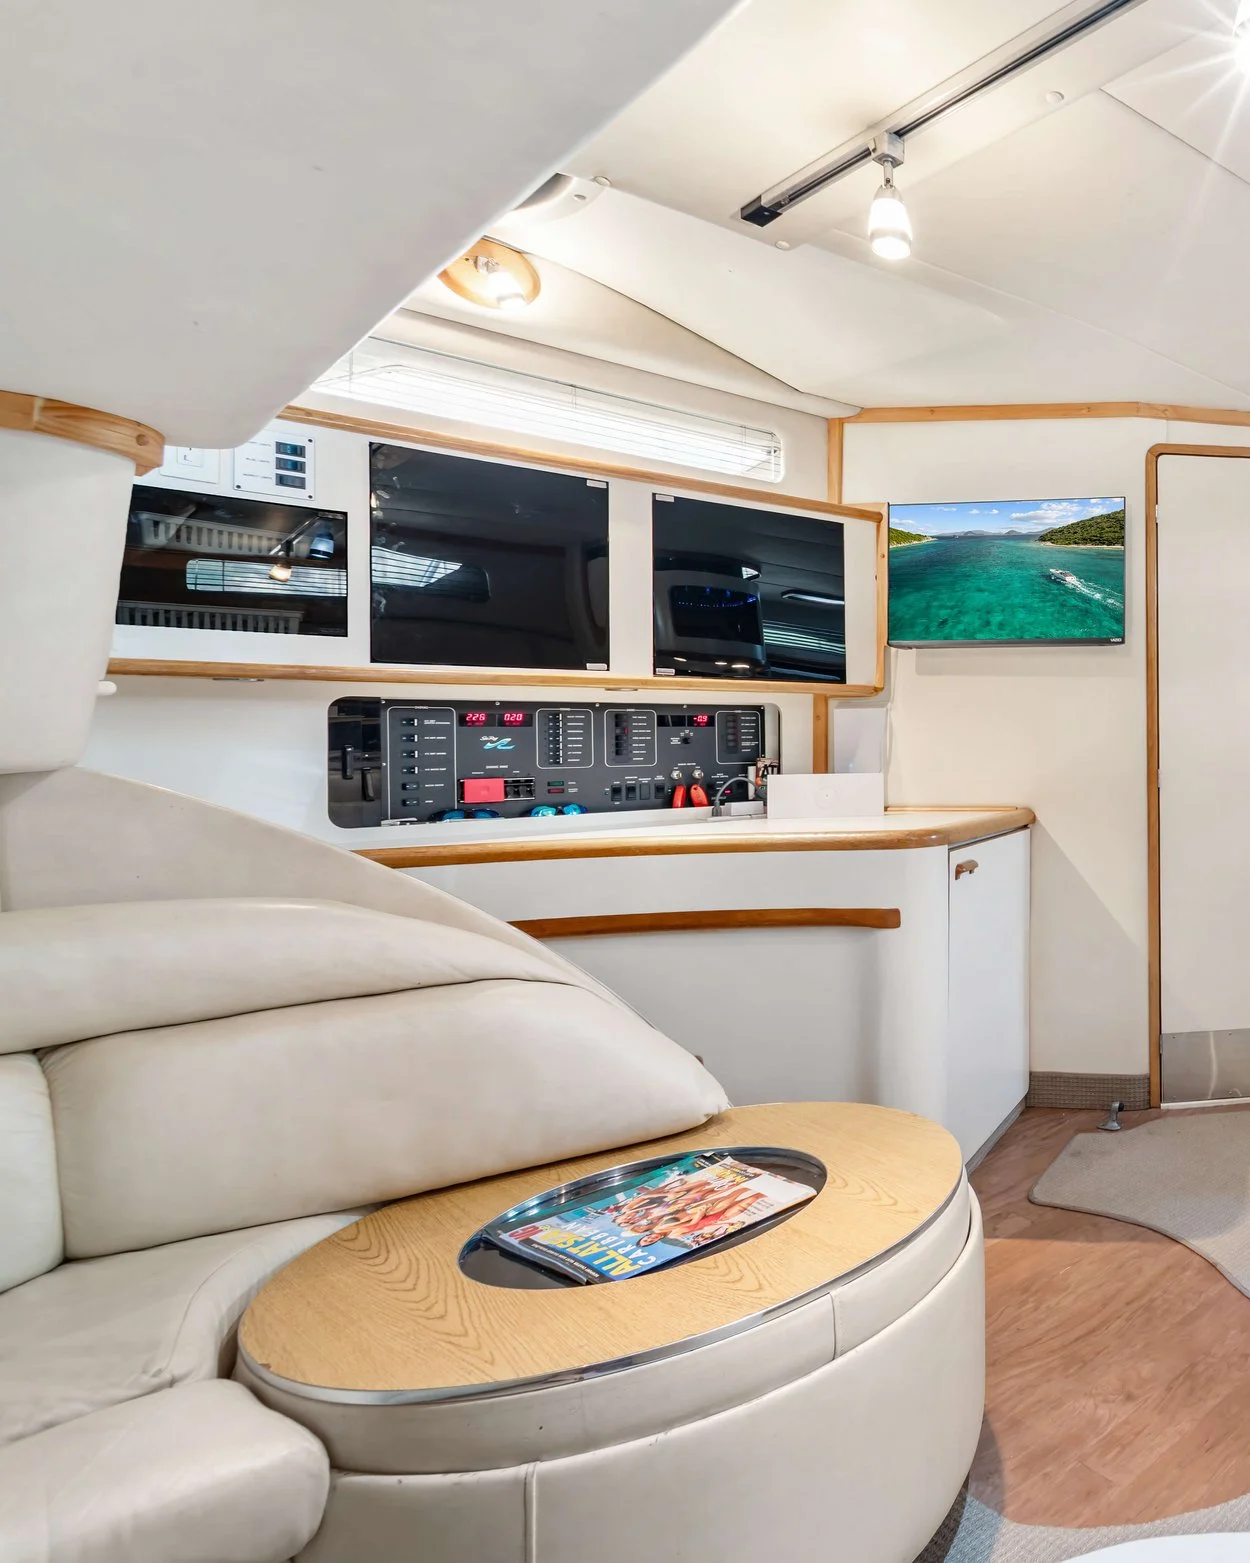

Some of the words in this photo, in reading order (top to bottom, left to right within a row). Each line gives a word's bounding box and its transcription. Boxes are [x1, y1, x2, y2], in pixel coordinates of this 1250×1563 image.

[561, 1221, 657, 1265] CARIBBEAN
[565, 1240, 602, 1257] AT
[592, 1250, 643, 1276] ALL
